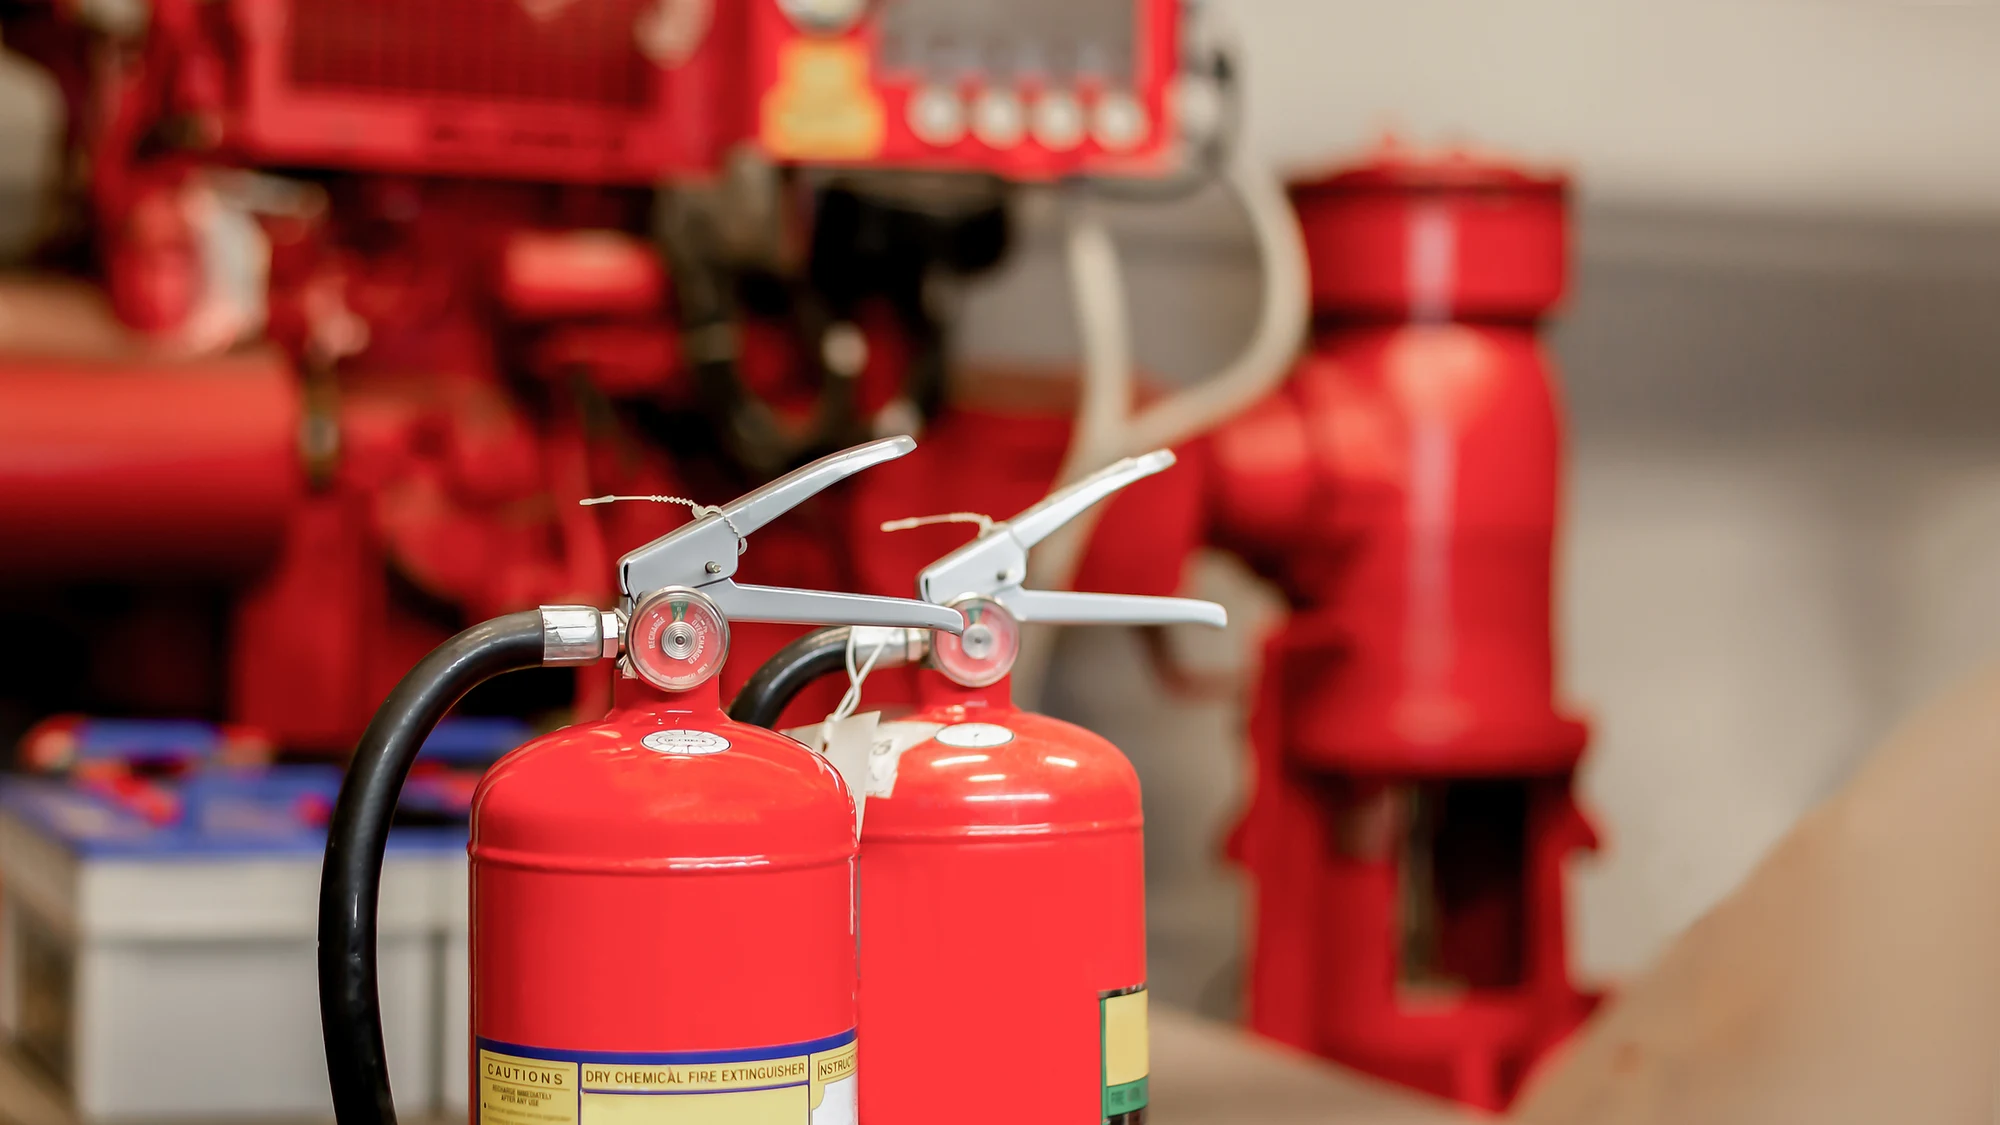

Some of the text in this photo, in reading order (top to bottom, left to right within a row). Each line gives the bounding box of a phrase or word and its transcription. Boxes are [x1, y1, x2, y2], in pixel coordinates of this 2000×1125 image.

[648, 616, 666, 649] RECHARGE
[688, 619, 705, 665] OVERCHARGED
[487, 1063, 563, 1085] CAUTIONS
[585, 1062, 805, 1084] DRY CHEMICAL FIRE EXTINGUISHER
